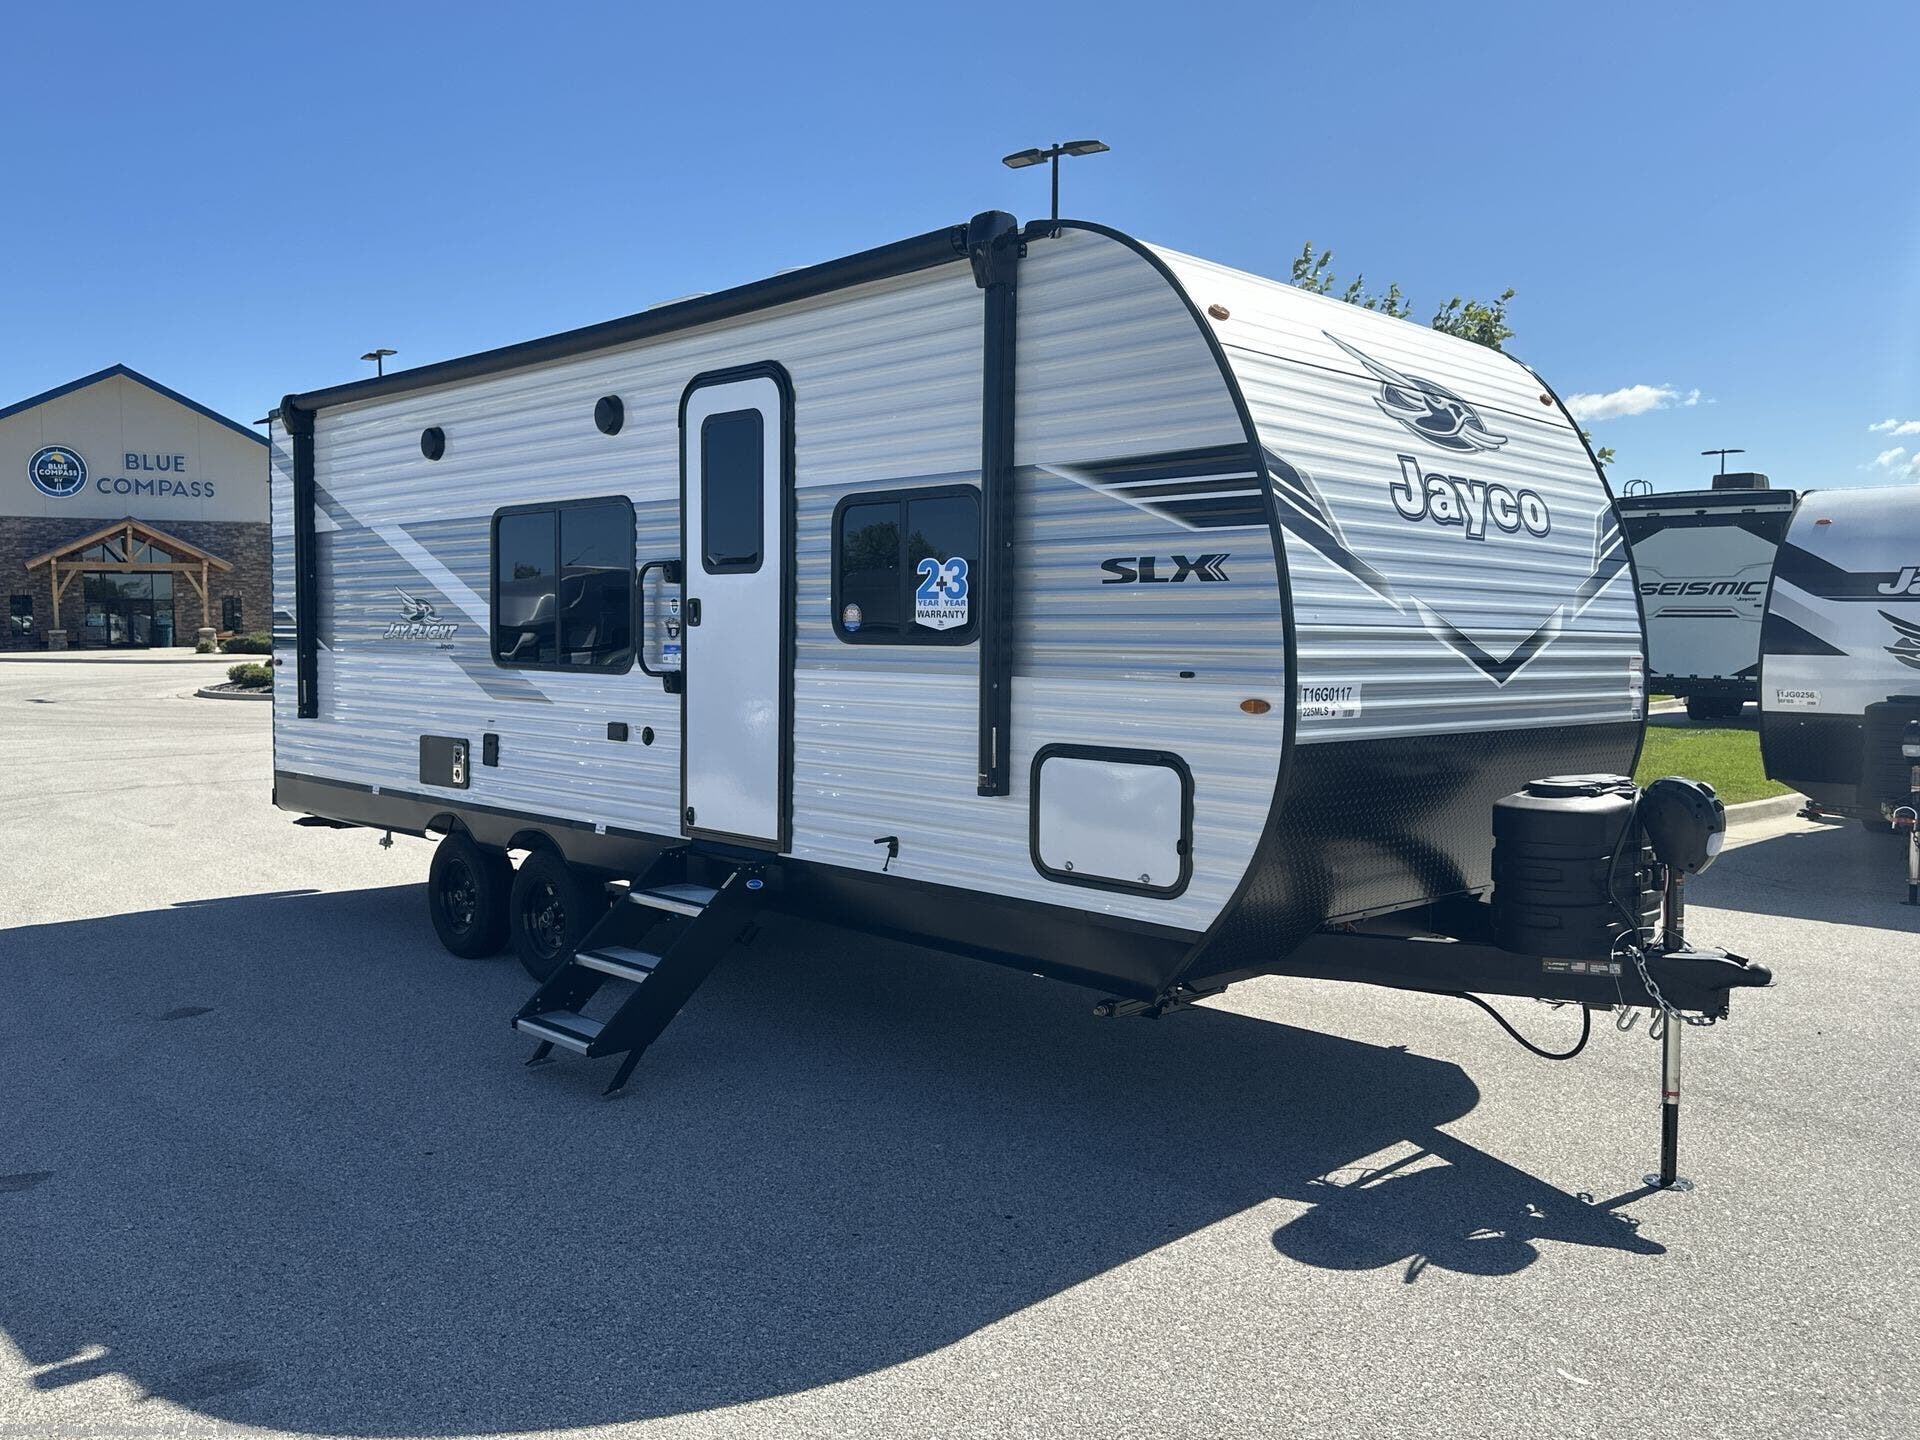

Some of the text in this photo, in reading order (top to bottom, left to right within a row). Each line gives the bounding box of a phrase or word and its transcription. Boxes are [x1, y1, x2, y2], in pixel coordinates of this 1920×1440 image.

[125, 453, 186, 473] BLUE
[96, 477, 215, 498] COMPASS
[1389, 453, 1551, 541] Jayco
[1101, 553, 1231, 584] SLX
[1640, 581, 1768, 596] SEISMIC
[917, 610, 966, 618] WARRANTY
[1303, 687, 1352, 702] T16G0117
[1303, 707, 1329, 717] 225MLS
